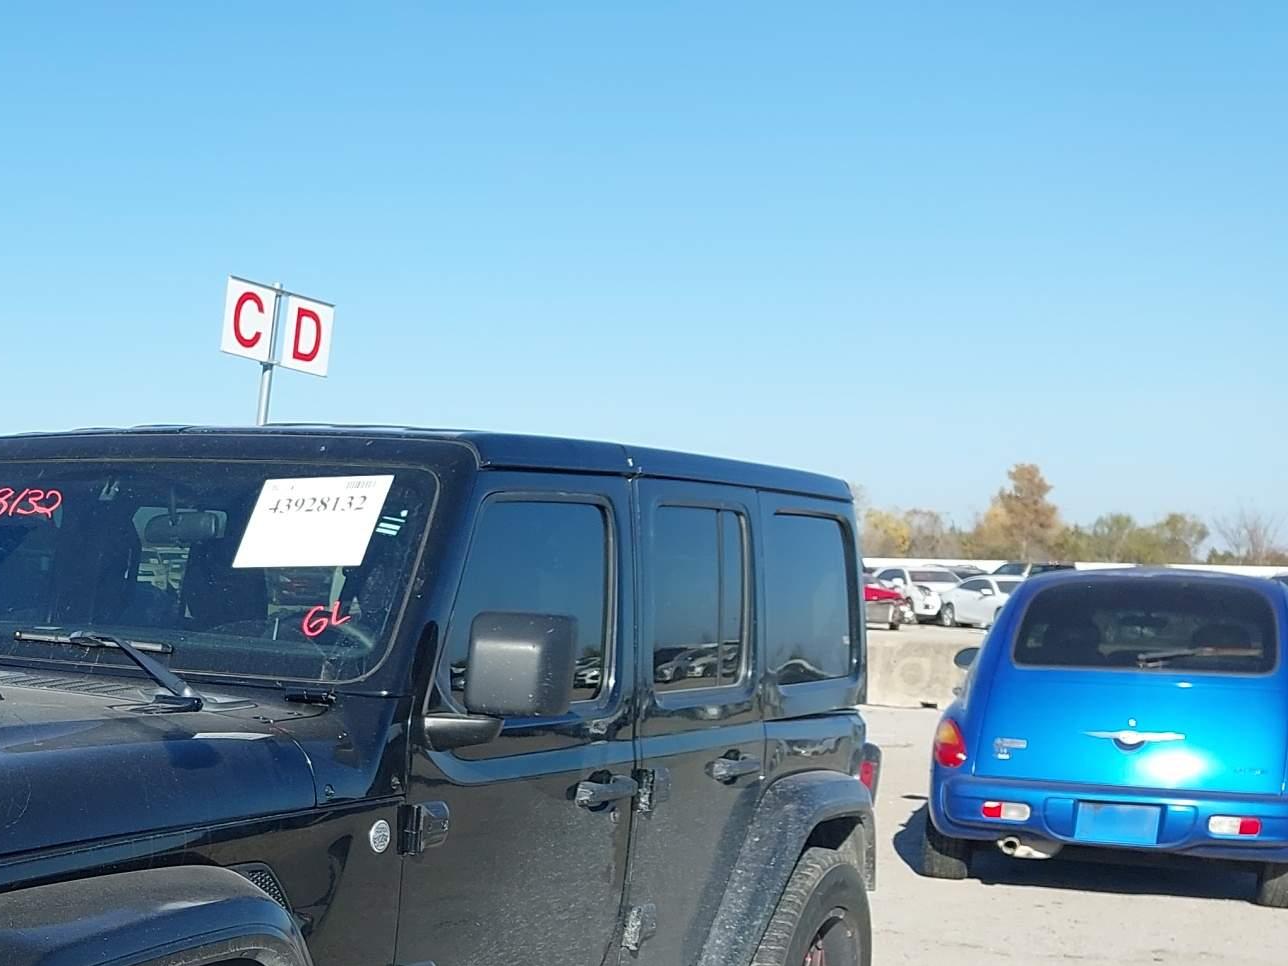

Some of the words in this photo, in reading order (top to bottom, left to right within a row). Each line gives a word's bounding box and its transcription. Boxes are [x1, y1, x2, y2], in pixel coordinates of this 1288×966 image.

[233, 291, 264, 348] C
[292, 306, 322, 362] D
[268, 495, 368, 514] 43928132
